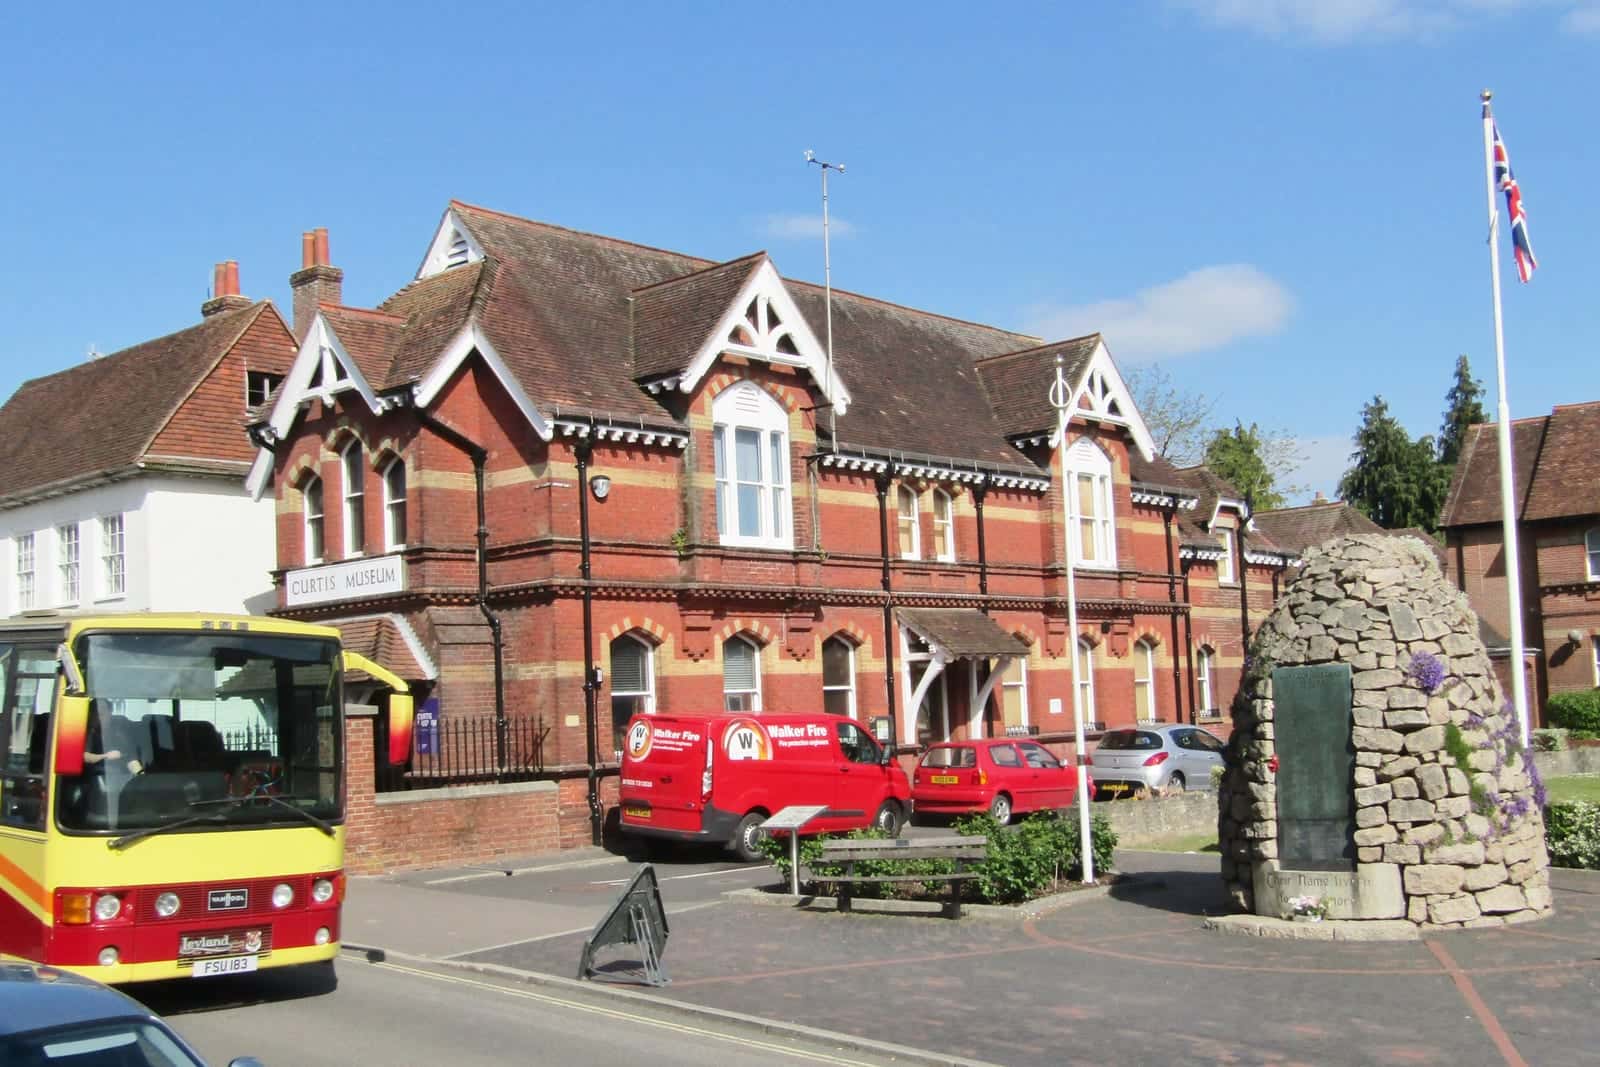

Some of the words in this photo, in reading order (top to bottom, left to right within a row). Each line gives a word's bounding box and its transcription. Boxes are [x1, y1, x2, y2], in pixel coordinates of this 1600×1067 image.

[292, 576, 336, 595] CURTIS
[345, 568, 395, 589] MUSEUM
[636, 728, 645, 738] W
[654, 728, 681, 739] Walker
[682, 730, 700, 742] Fire
[767, 725, 805, 738] Walker
[806, 724, 828, 737] Fire
[738, 732, 753, 750] W
[204, 960, 228, 973] FSU
[230, 958, 248, 970] 183
